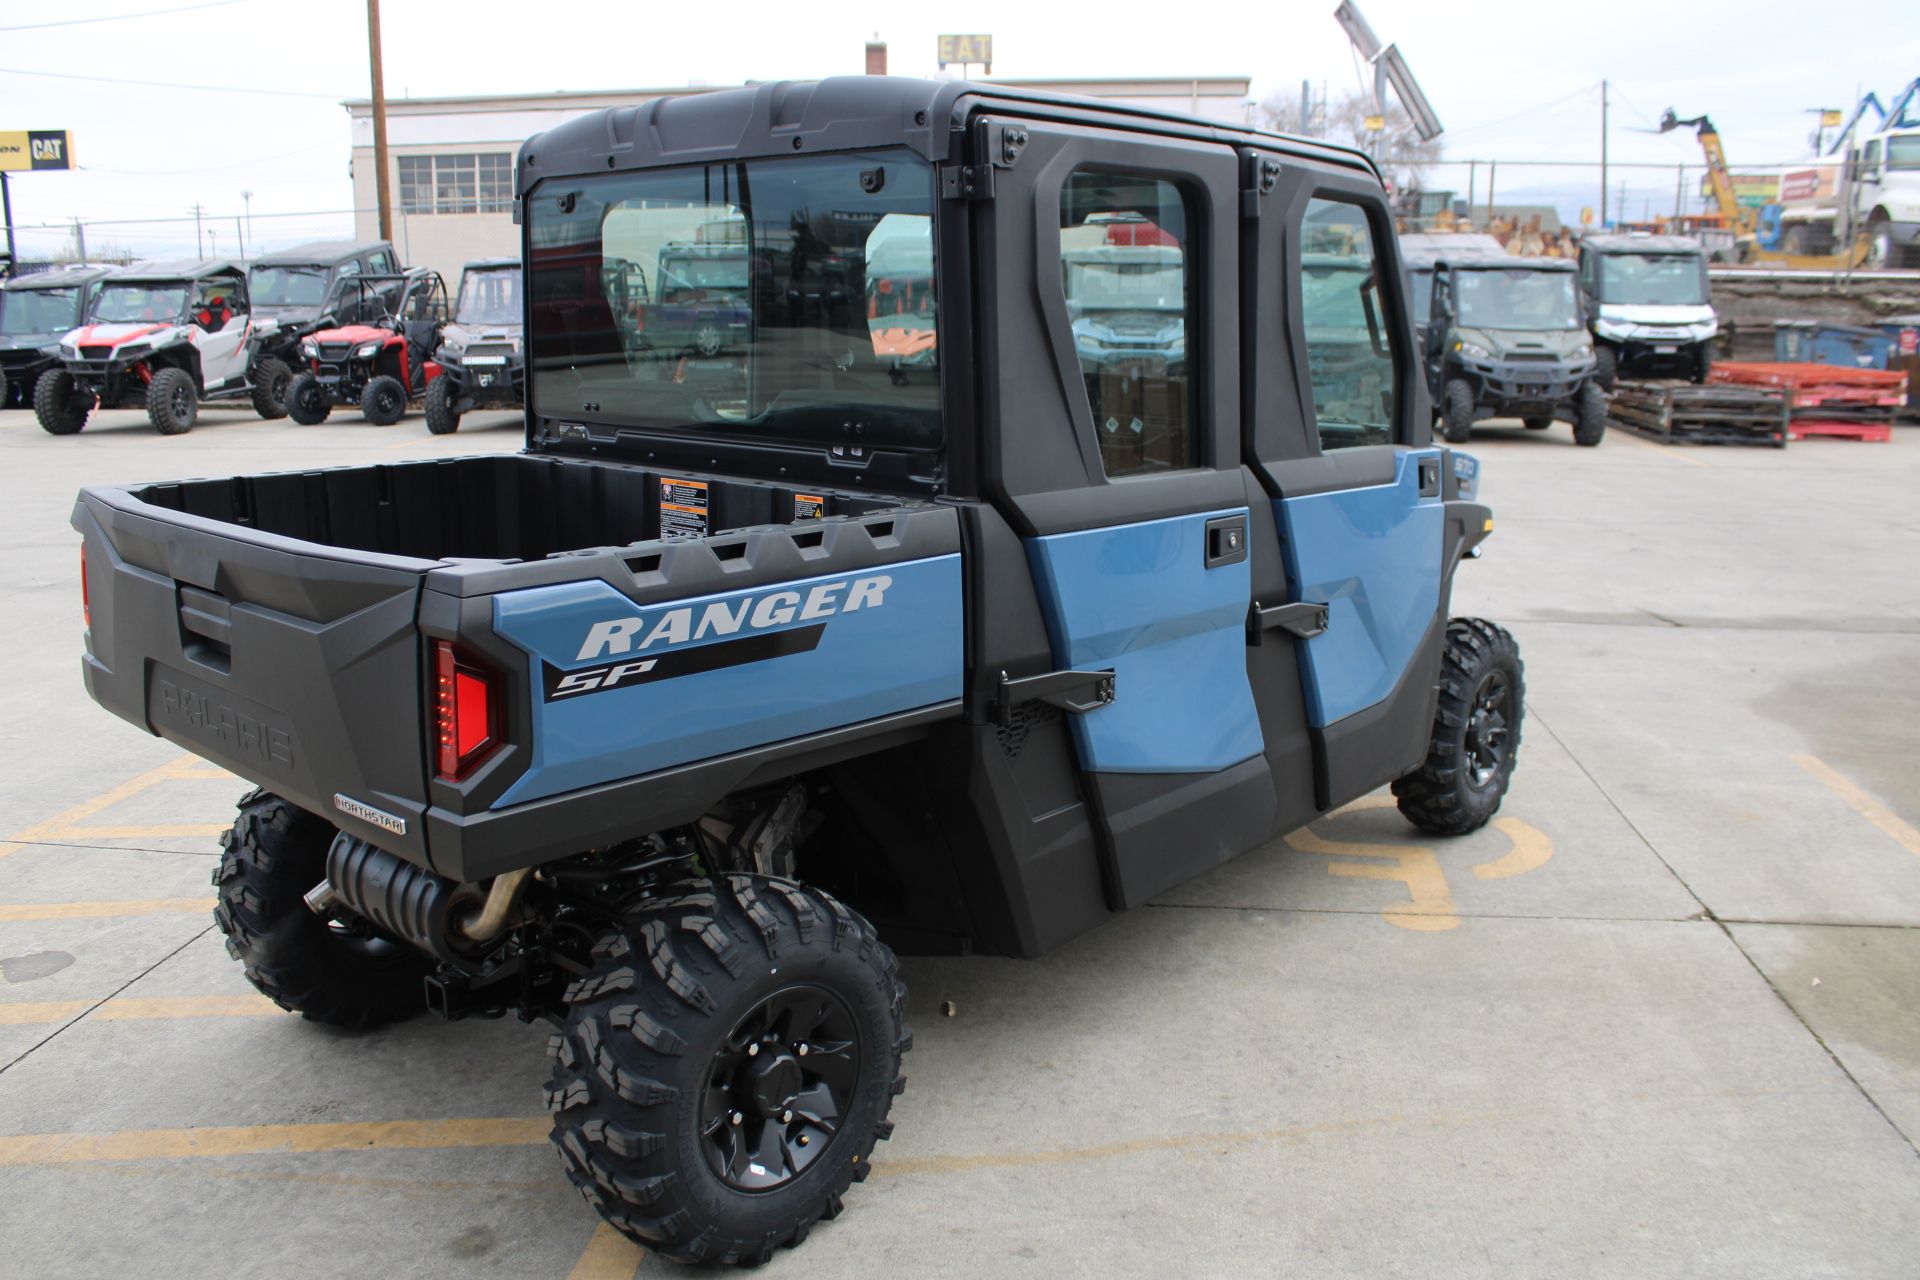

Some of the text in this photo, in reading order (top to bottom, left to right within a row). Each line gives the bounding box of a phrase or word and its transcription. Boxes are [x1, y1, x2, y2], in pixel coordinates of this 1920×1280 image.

[940, 36, 990, 60] EAT
[32, 138, 62, 160] CAT
[575, 575, 893, 661] RANGER
[551, 658, 658, 698] SP
[159, 679, 295, 771] POLARIS
[336, 796, 401, 831] NORTHSTAR
